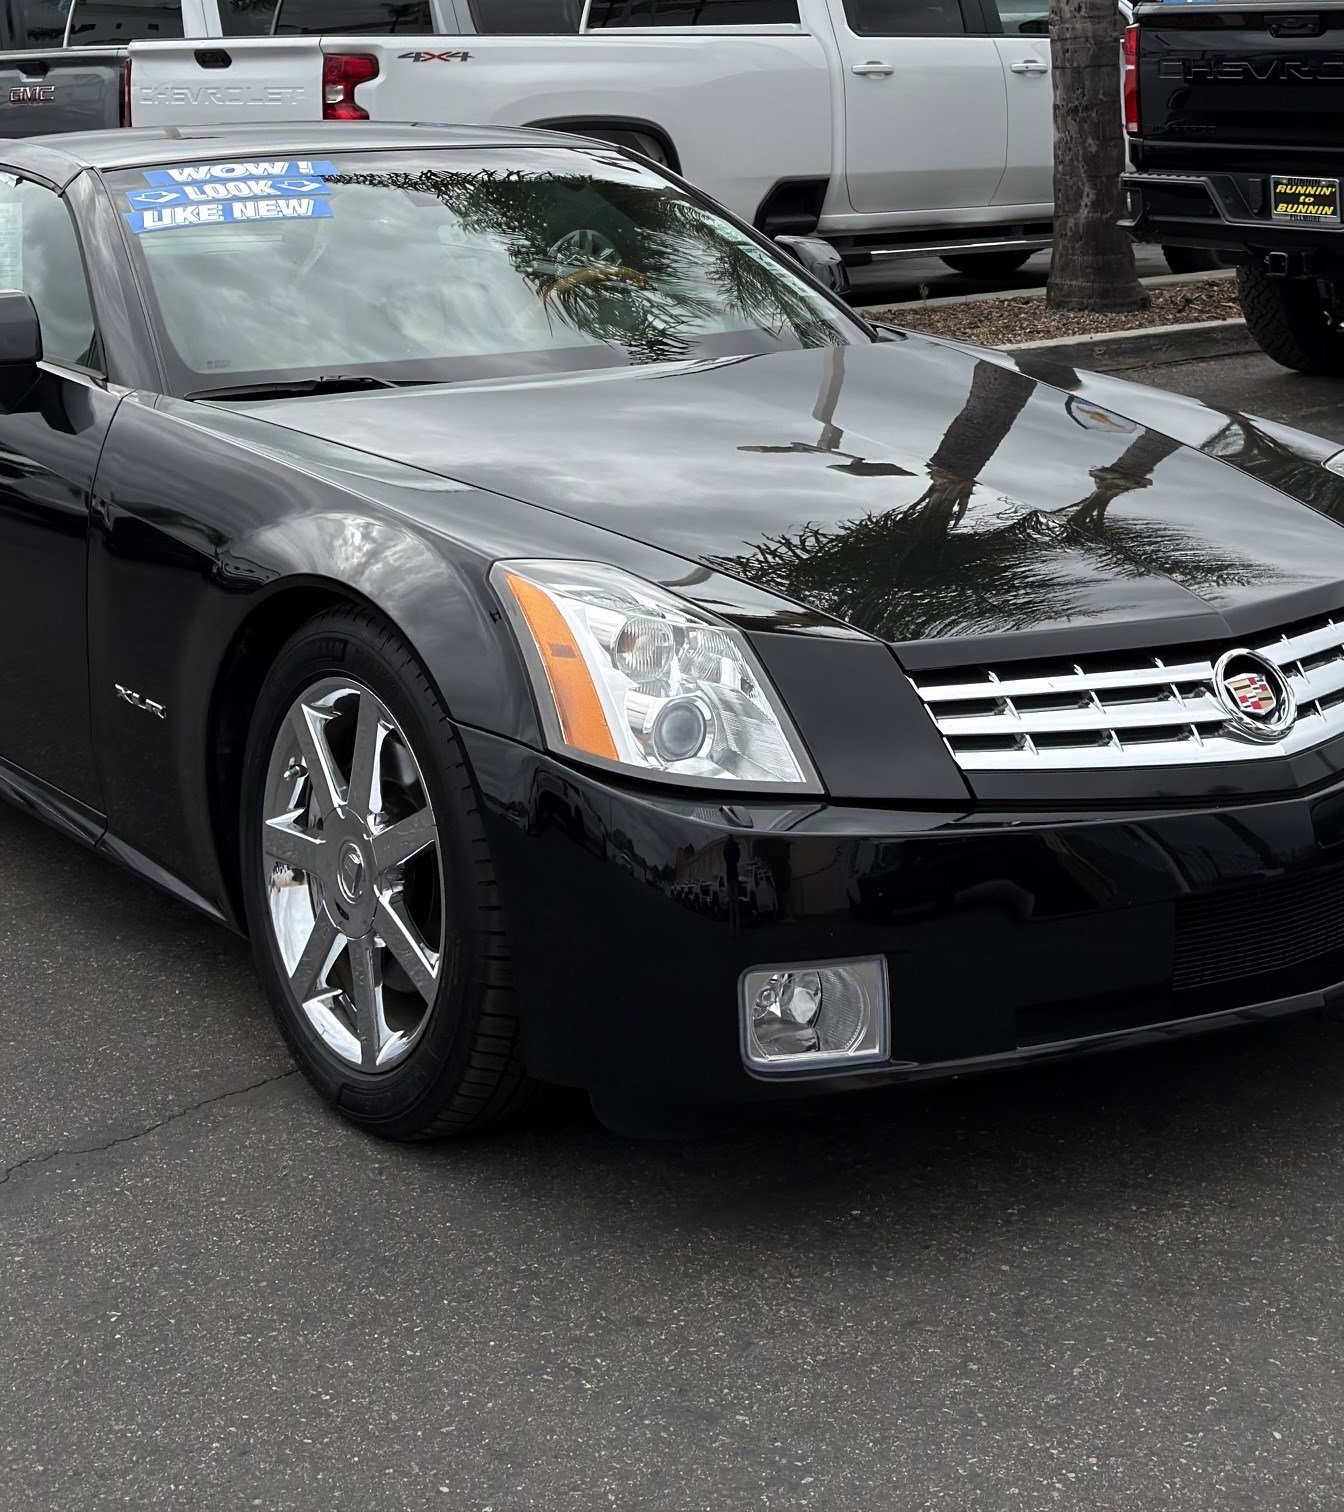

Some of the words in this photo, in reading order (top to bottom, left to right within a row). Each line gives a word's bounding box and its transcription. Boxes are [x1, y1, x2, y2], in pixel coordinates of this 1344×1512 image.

[9, 85, 55, 104] GMC
[139, 86, 306, 105] CHEVROLET
[183, 180, 281, 201] LOOK
[1276, 184, 1336, 196] RUNNIN'
[1299, 195, 1315, 203] to
[142, 204, 224, 229] LIKE
[232, 198, 316, 220] NEW
[1276, 203, 1334, 215] BUNNIN
[114, 683, 167, 719] XLR
